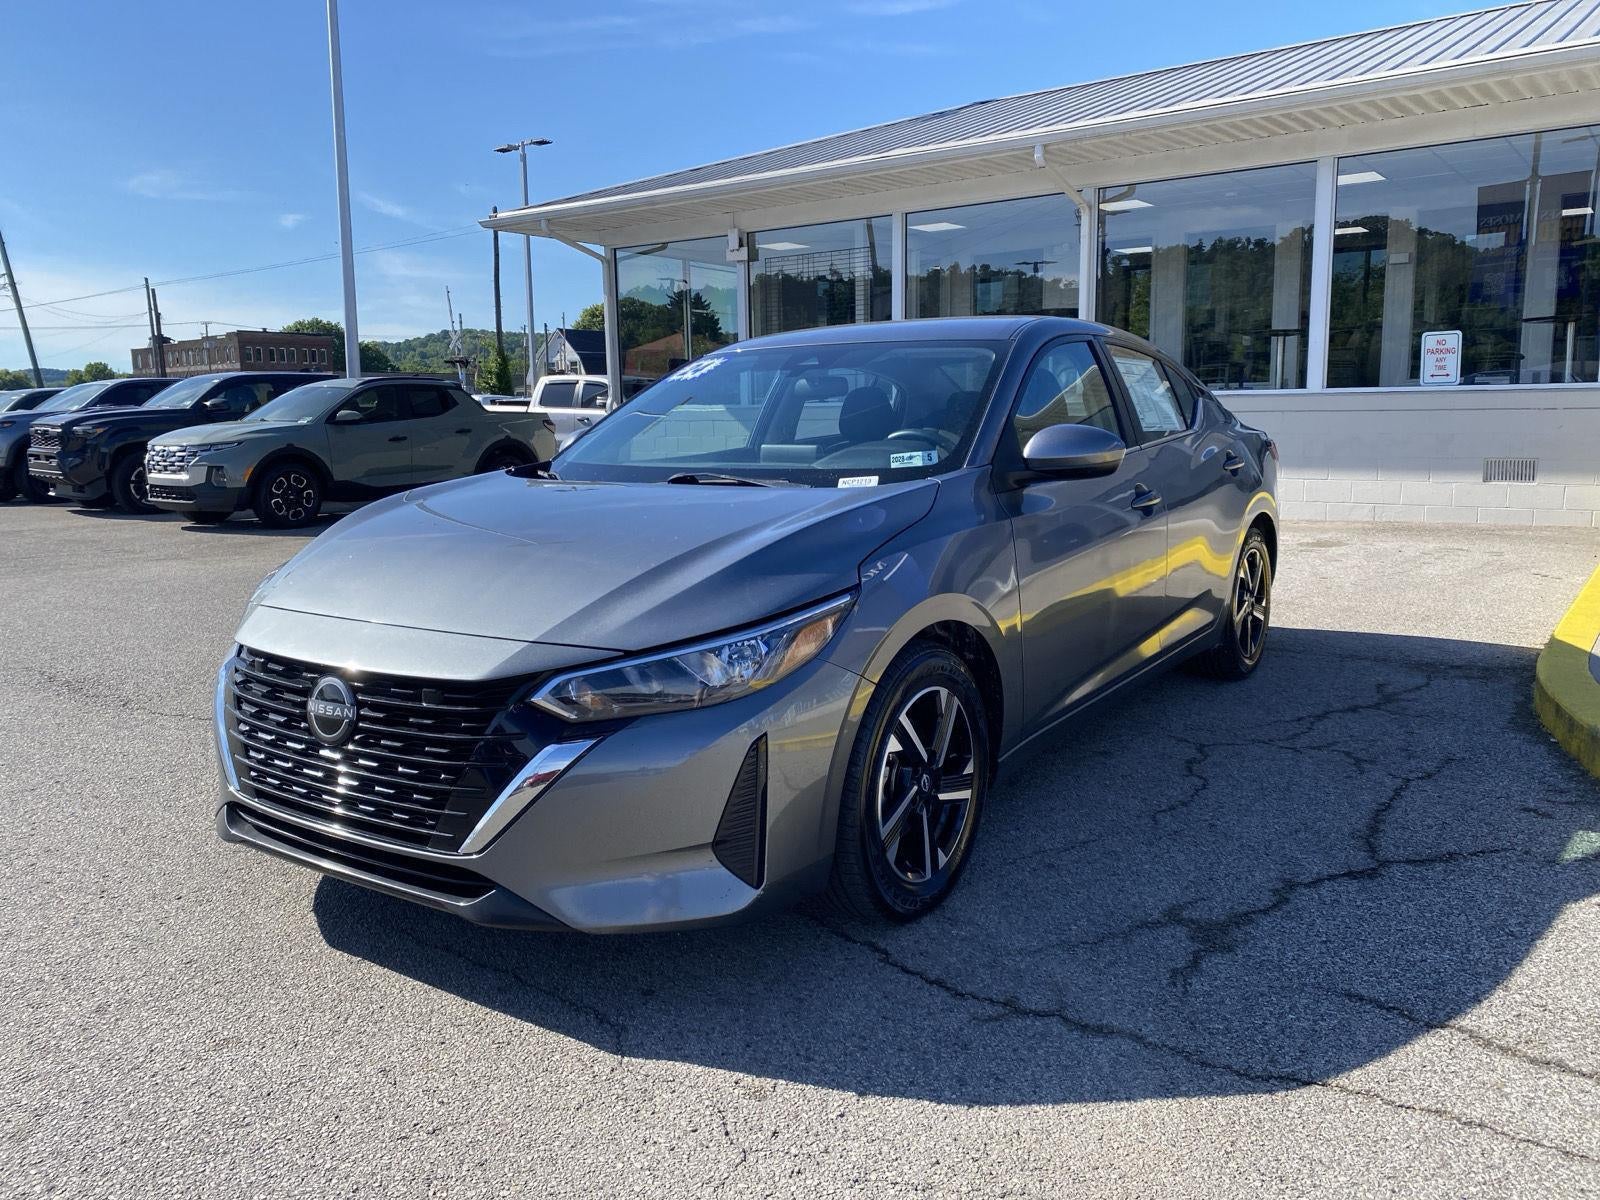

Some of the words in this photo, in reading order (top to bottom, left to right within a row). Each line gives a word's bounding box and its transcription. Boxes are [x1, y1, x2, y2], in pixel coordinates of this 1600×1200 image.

[1426, 347, 1456, 356] PARKING
[927, 453, 932, 462] 5
[308, 698, 353, 718] NISSAN
